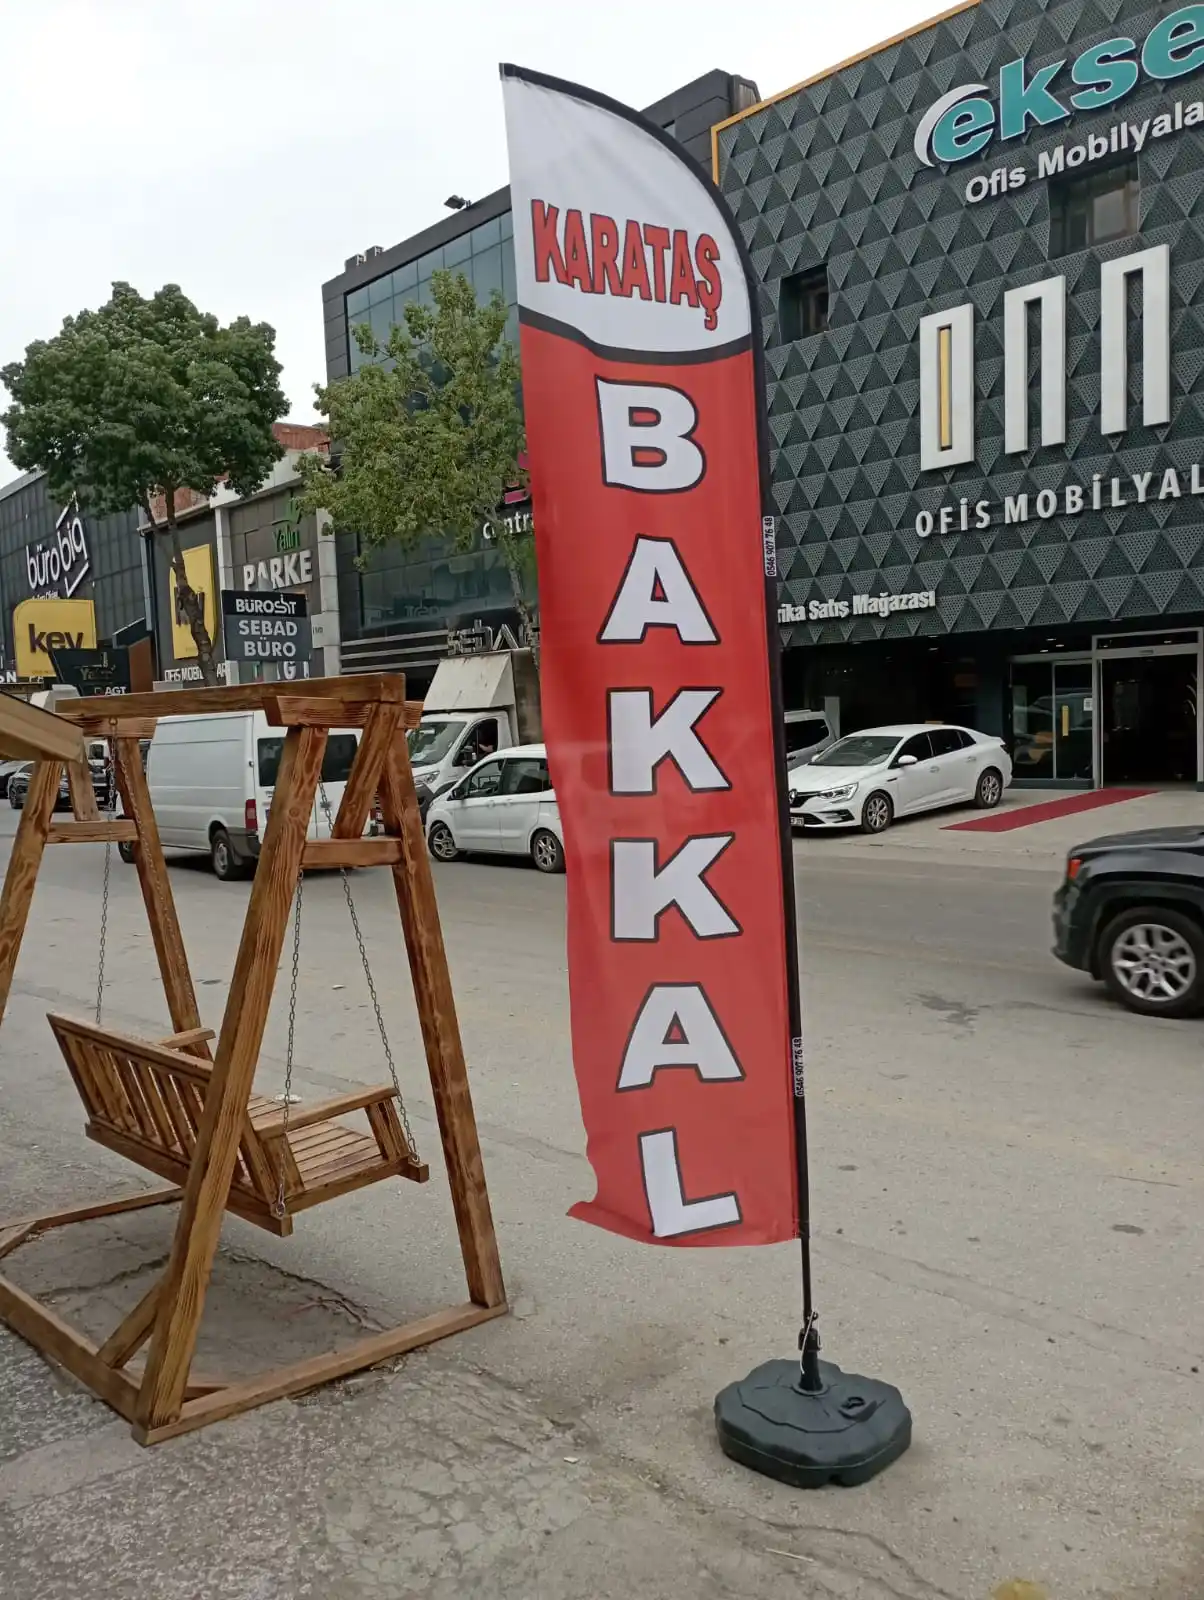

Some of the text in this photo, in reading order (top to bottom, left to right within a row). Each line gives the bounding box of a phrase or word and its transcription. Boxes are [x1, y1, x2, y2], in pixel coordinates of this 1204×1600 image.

[965, 165, 1027, 204] Ofis
[531, 199, 723, 331] KARATAŞ
[914, 497, 992, 538] OFİS
[764, 517, 776, 576] 0546 907 76 48
[808, 598, 850, 619] Satış
[852, 591, 936, 618] Mağazası
[238, 620, 298, 637] SEBAD
[244, 637, 297, 658] BÜRO
[595, 374, 746, 1239] BAKKAL
